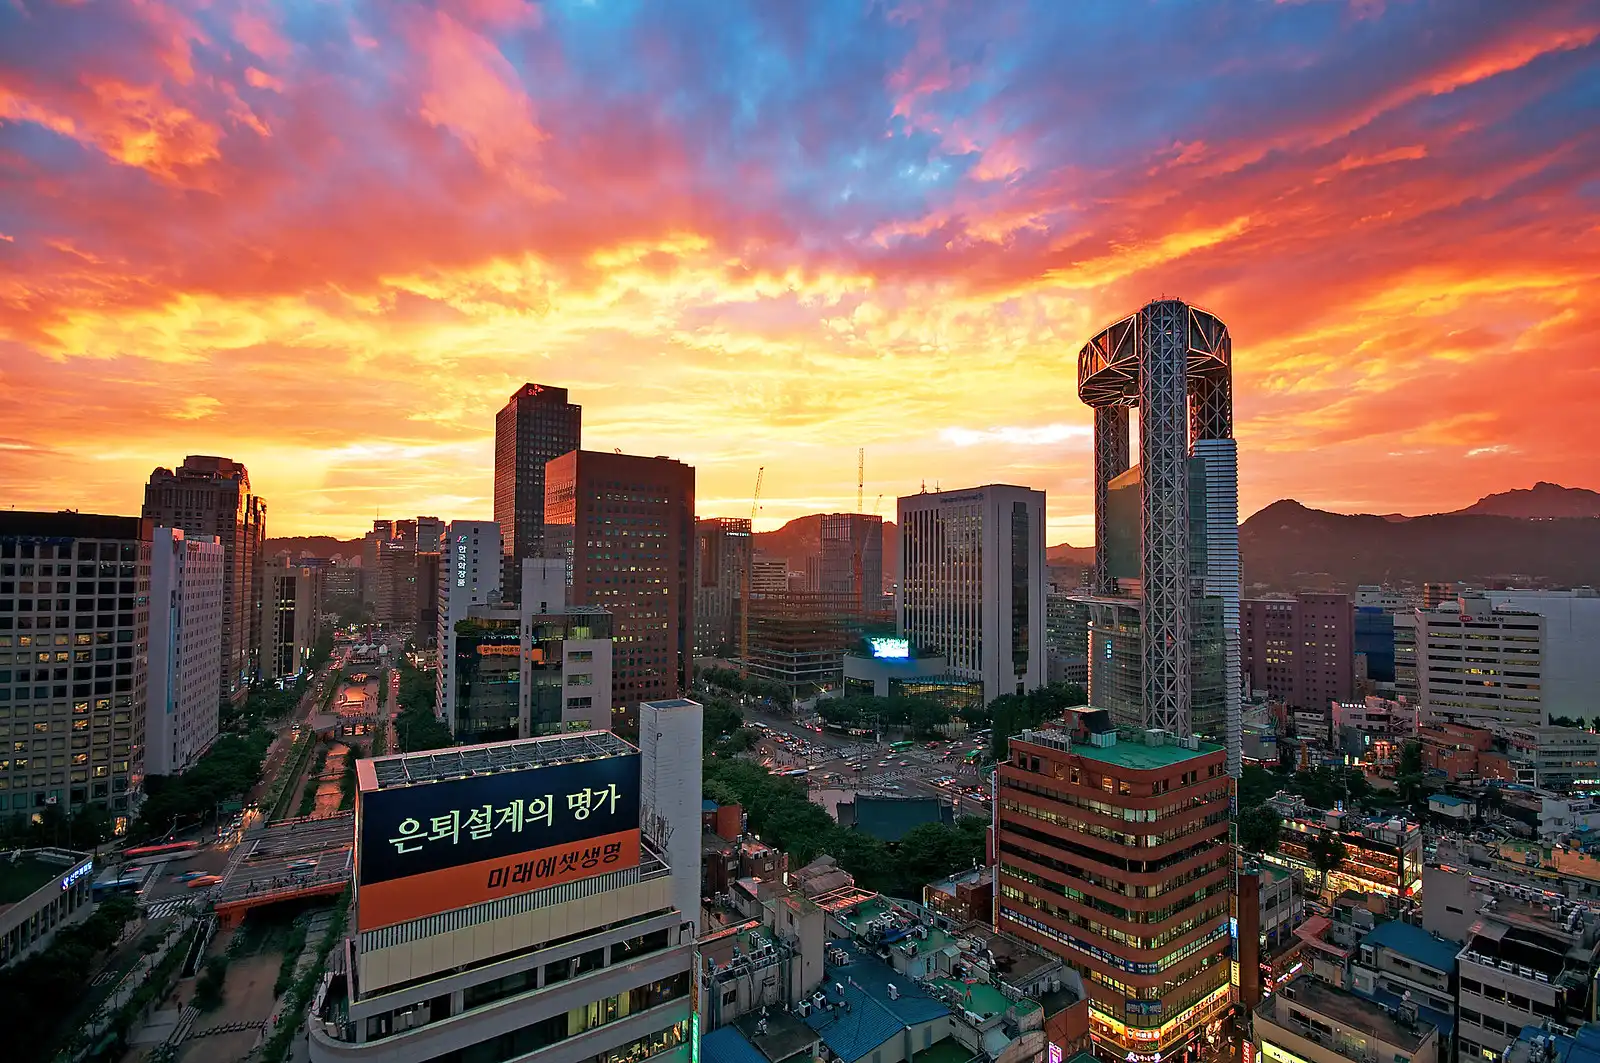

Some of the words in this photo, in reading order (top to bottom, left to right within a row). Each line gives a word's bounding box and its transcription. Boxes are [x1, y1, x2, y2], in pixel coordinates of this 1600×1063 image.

[457, 545, 467, 587] 한국화장품
[657, 732, 663, 741] P
[389, 794, 553, 854] 은퇴설계의
[566, 783, 621, 820] 명가
[487, 842, 622, 889] 미래에셋생명
